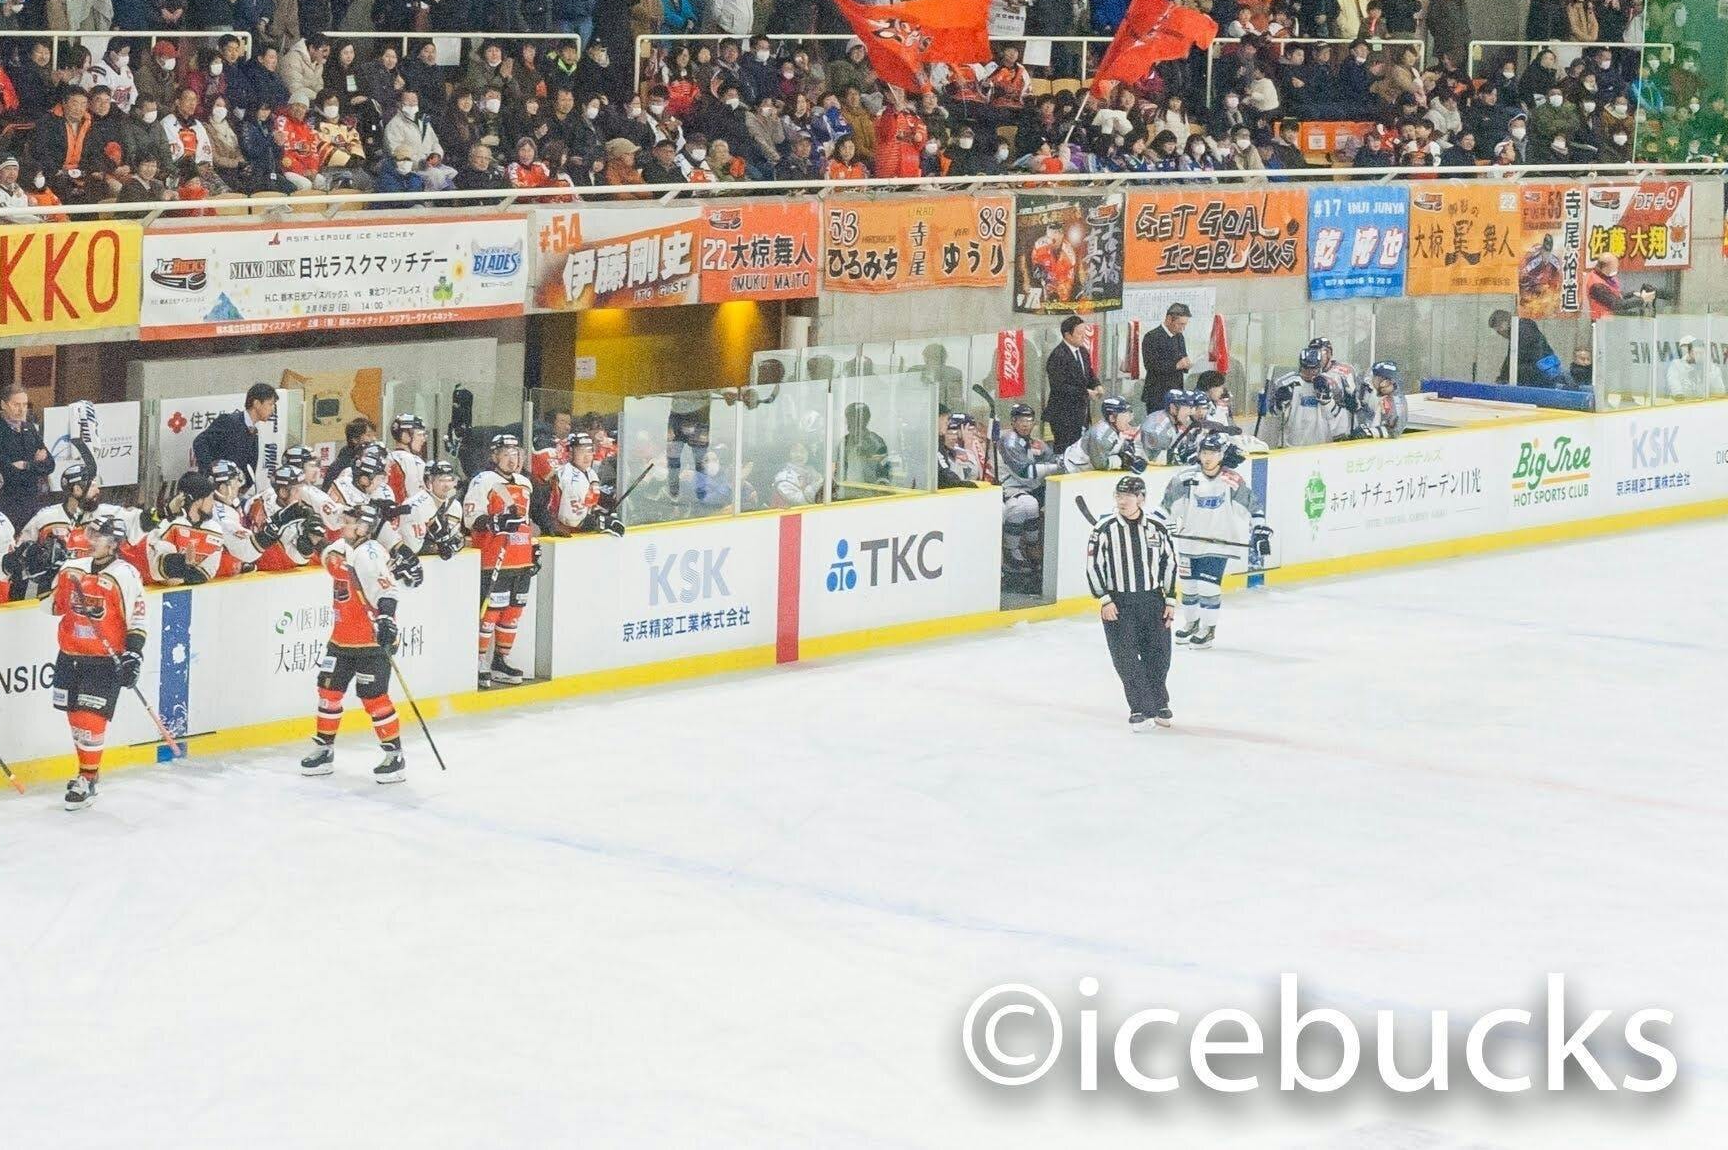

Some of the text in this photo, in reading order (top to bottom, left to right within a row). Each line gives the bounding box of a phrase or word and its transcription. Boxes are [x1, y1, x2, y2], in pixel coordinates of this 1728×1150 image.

[979, 206, 1007, 239] 88
[1135, 203, 1198, 240] GET
[1313, 198, 1342, 218] #17
[539, 211, 583, 253] #54
[909, 220, 928, 277] 寺尾
[229, 261, 264, 280] NIKKO
[299, 249, 448, 280] 日光ラスクマッチデー
[562, 230, 694, 302] 伊藤剛史
[827, 247, 898, 281] ひろみち
[943, 241, 1005, 276] ゆうり
[1156, 237, 1298, 274] ICEBUCKS
[1329, 467, 1482, 513] ホテル ナチュラルガーデン日光
[1513, 483, 1590, 507] HOT SPORTS CLUB
[860, 530, 945, 588] TKC
[621, 605, 751, 643] 京浜精密工業株式会社
